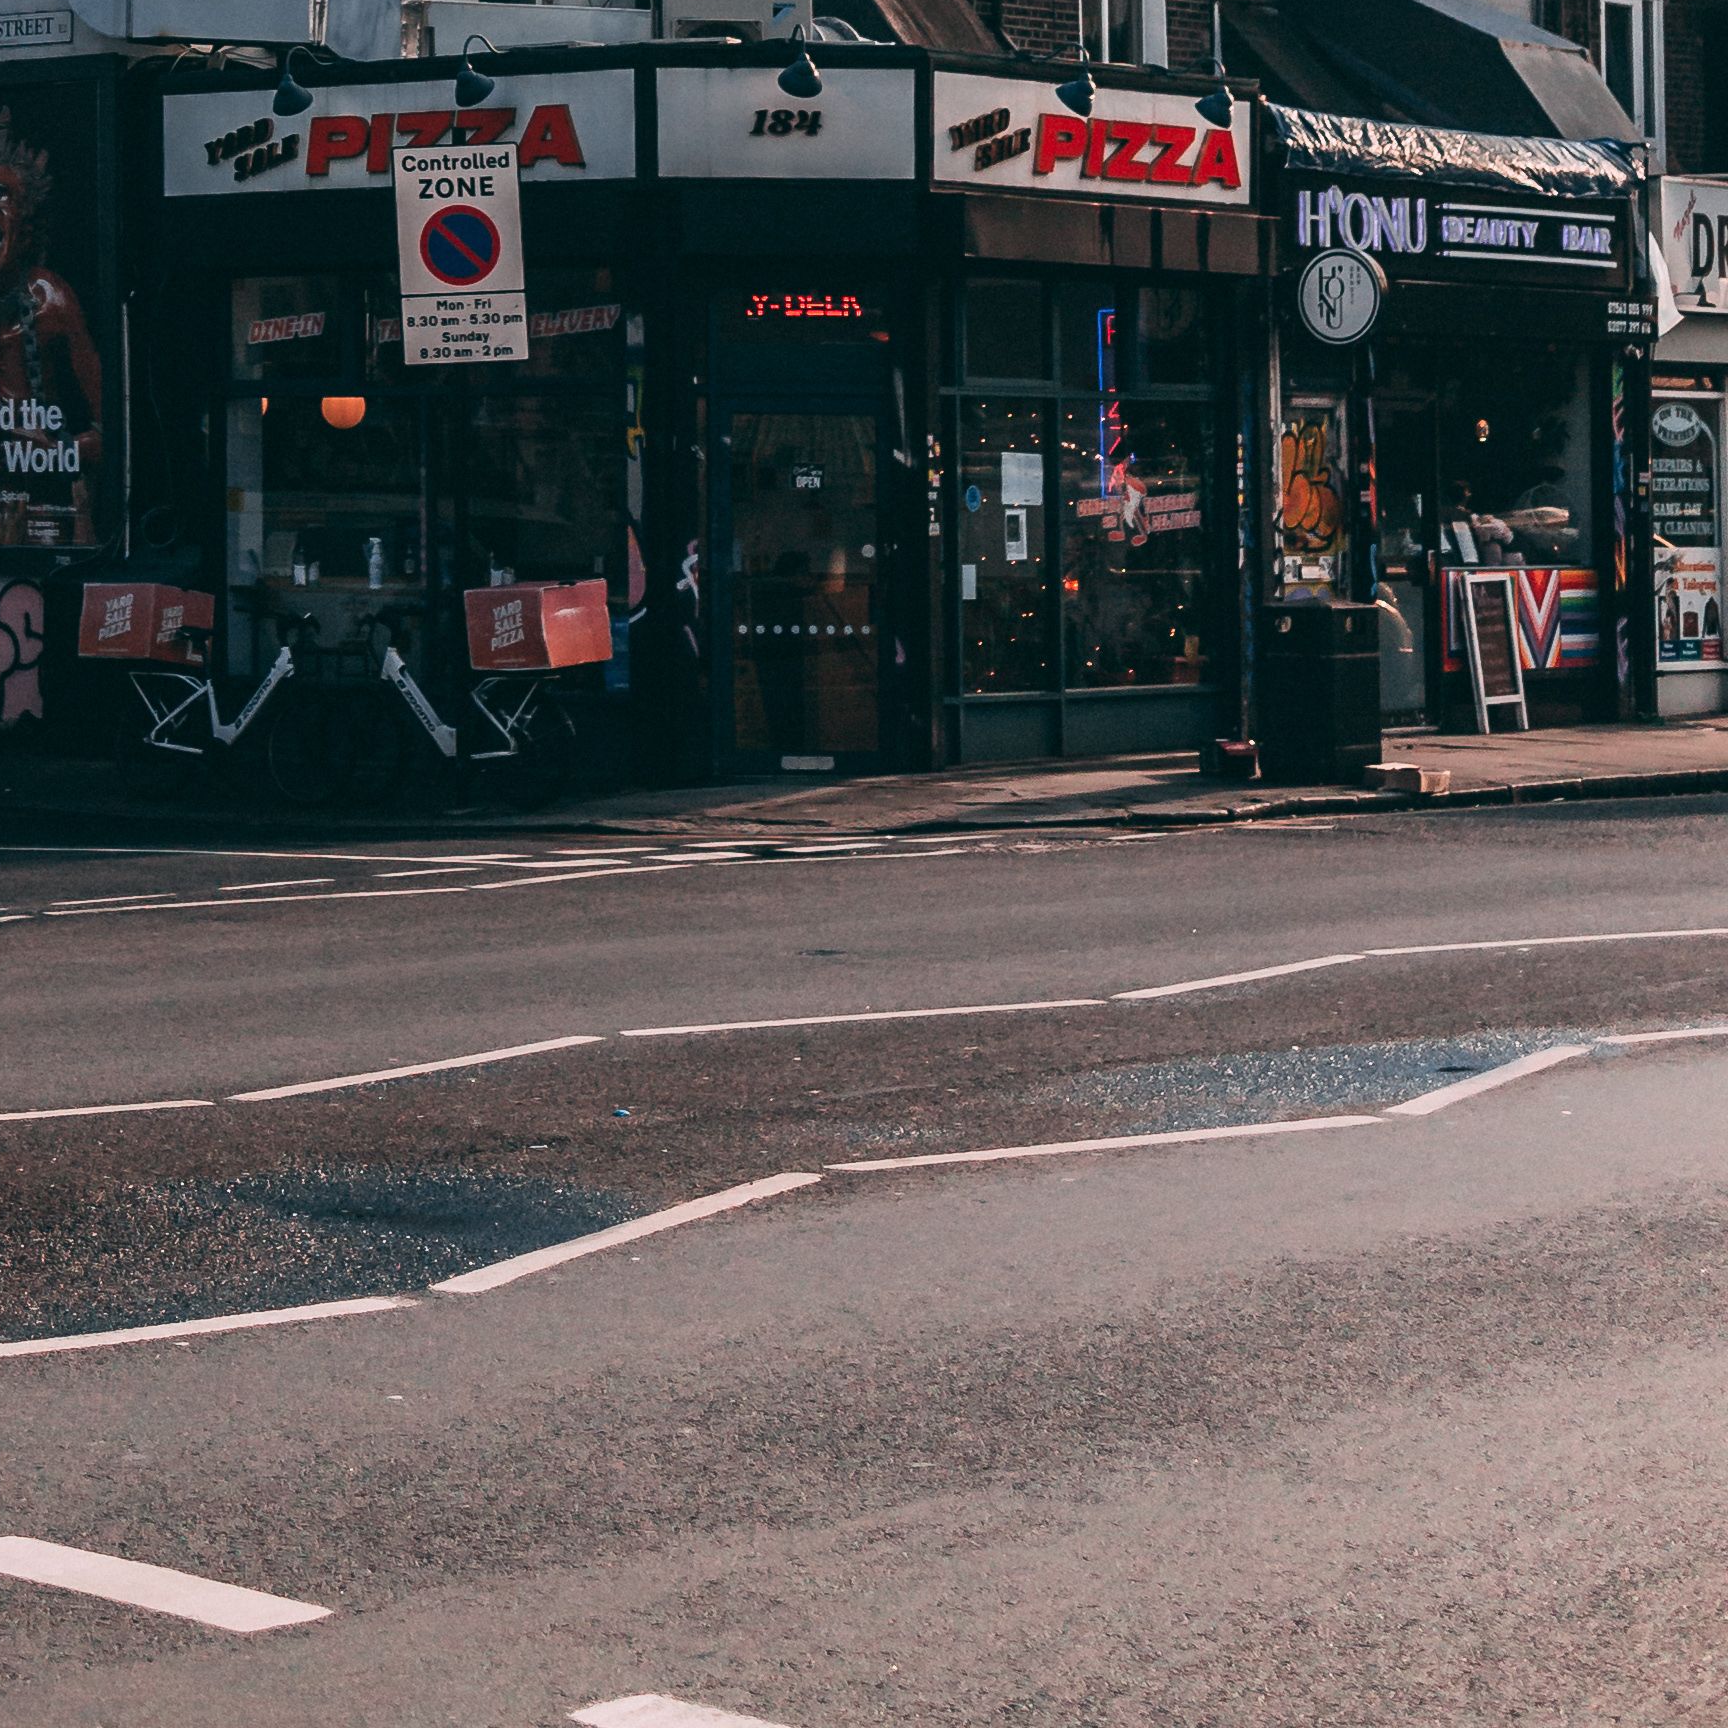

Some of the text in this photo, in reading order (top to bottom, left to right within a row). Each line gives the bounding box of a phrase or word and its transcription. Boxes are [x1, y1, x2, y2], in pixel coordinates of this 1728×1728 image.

[748, 109, 822, 137] 184
[306, 103, 586, 175] PIZZA
[1033, 112, 1241, 189] PIZZA
[401, 152, 510, 172] Controlled
[419, 176, 495, 199] ZONE
[1442, 216, 1539, 248] BEAUTY
[1562, 224, 1612, 254] BAR
[437, 298, 491, 310] Mon Fri
[407, 314, 523, 327] 8.30 am 5.30 pm
[530, 304, 620, 338] ELIVERY
[442, 332, 489, 344] Sunday
[420, 346, 513, 359] 8.30 am 2 pm
[20, 399, 62, 431] the
[4, 440, 80, 473] World
[493, 600, 522, 620] YARD
[495, 614, 522, 634] SALE
[491, 629, 524, 652] PIZZA
